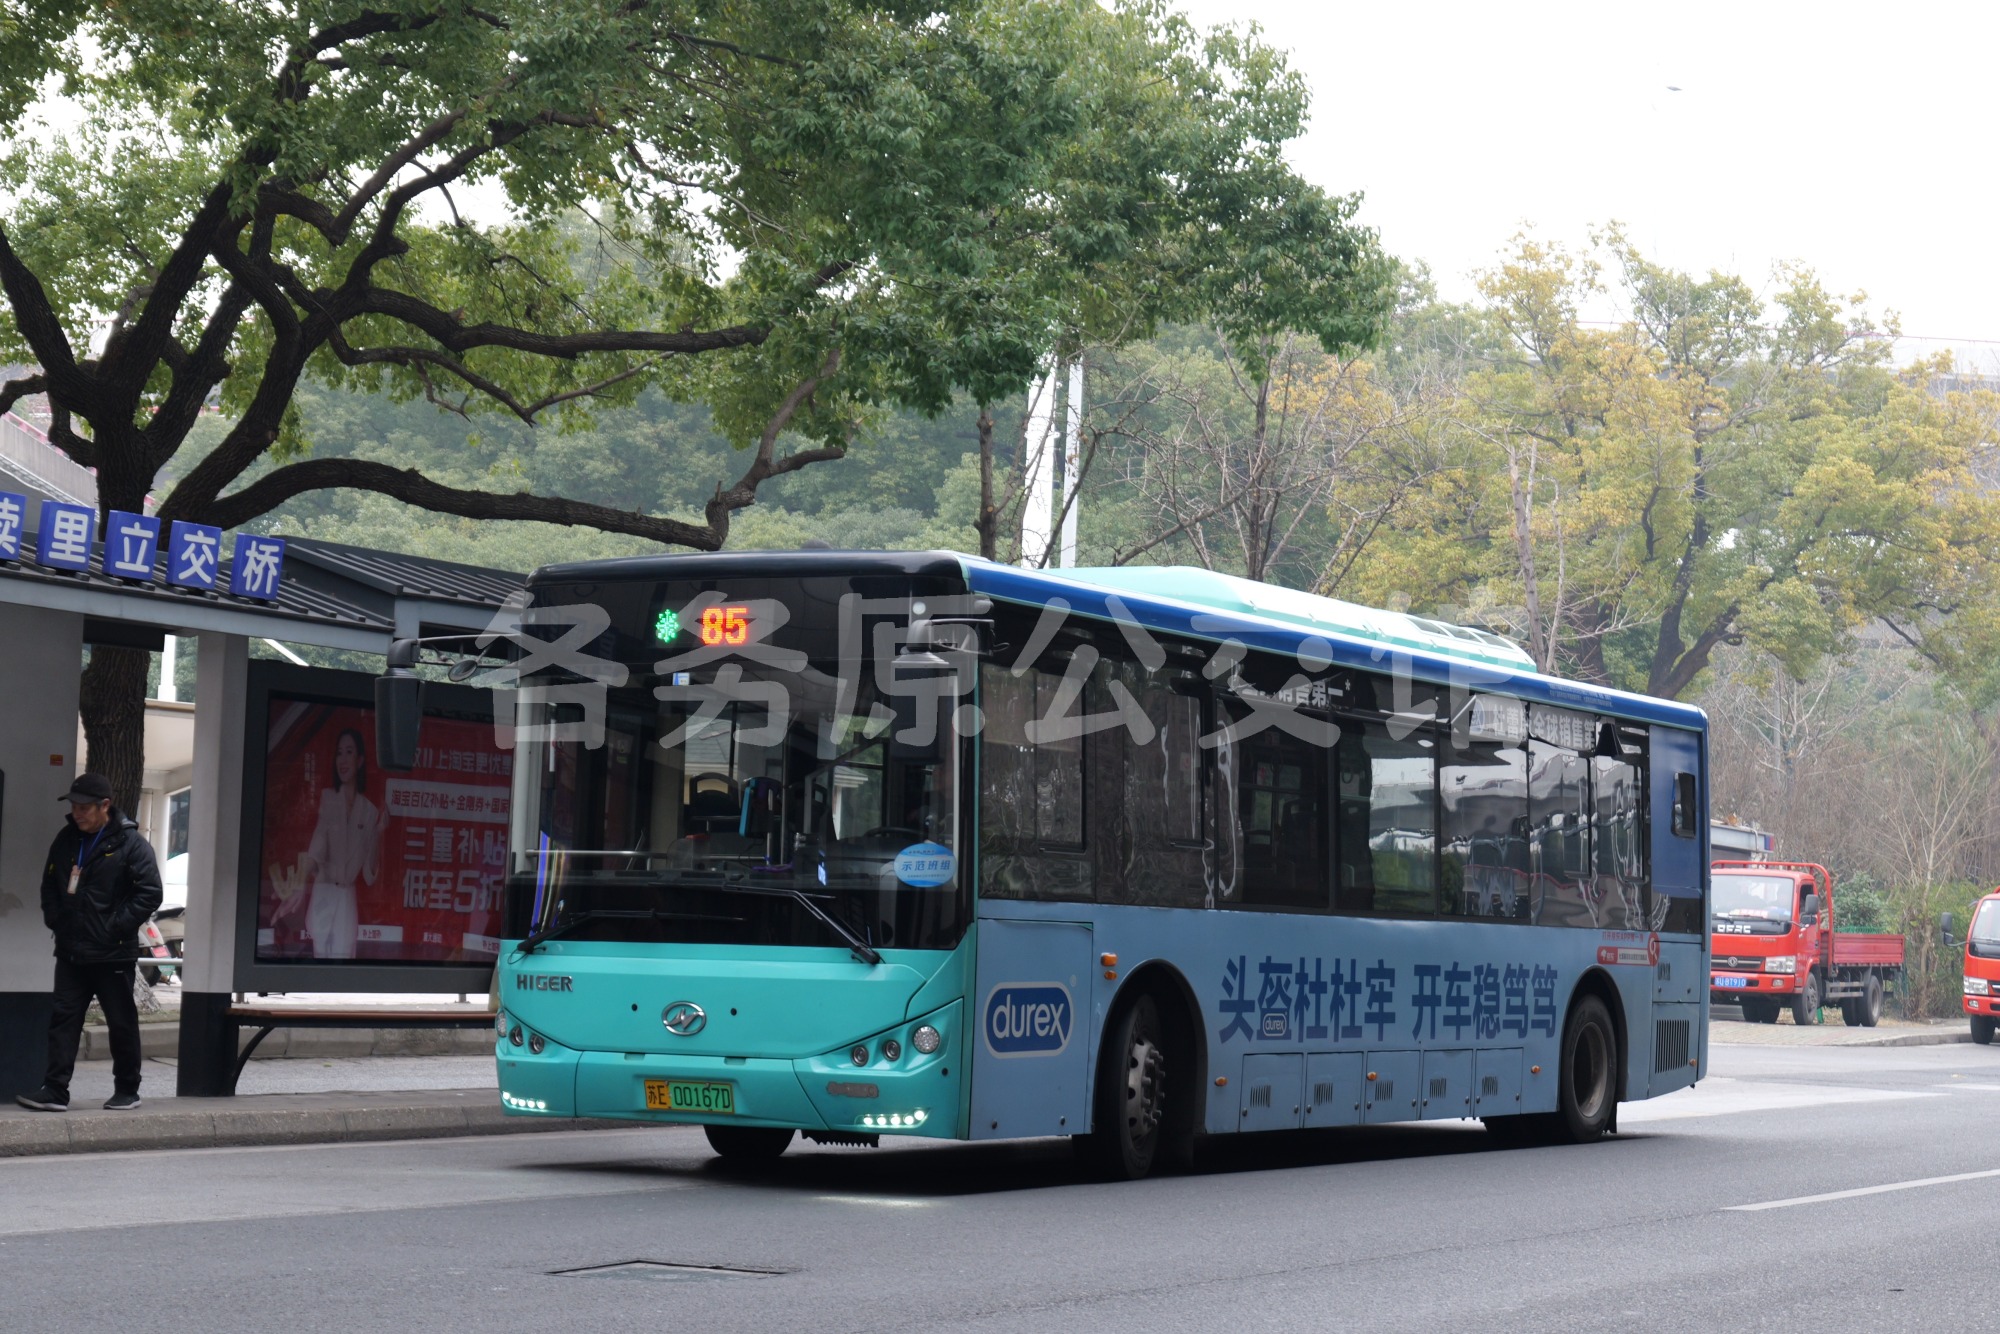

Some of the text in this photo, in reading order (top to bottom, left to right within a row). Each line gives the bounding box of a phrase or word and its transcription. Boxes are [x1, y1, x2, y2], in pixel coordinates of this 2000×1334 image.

[702, 607, 747, 645] 85
[403, 826, 506, 867] 三重补贴
[901, 859, 951, 872] 示范班组
[402, 869, 505, 914] 低至5折
[516, 974, 574, 993] HIGER
[1218, 955, 1558, 1045] 头盔杜杜牢 开车稳笃笃
[992, 994, 1066, 1047] durex
[1264, 1016, 1285, 1032] durex
